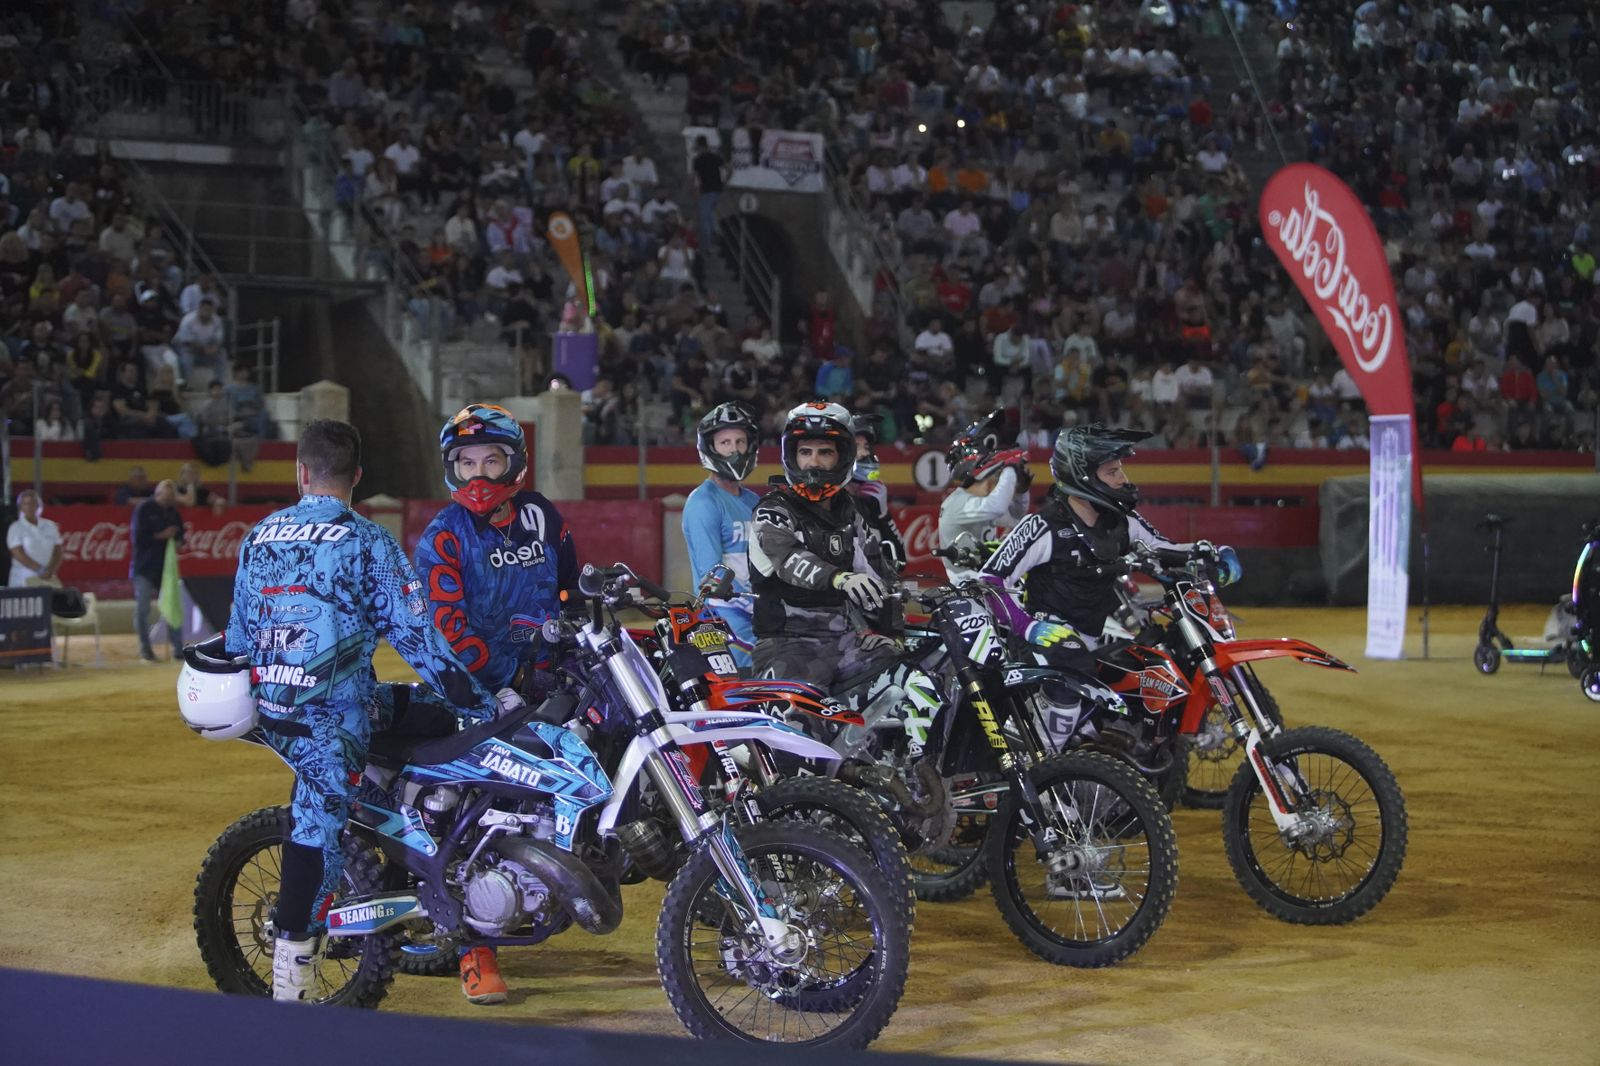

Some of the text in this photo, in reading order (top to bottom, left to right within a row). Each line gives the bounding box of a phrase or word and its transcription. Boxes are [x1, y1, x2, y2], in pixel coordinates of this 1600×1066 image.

[926, 456, 938, 487] 1
[253, 523, 351, 545] JABATO
[522, 556, 546, 568] Racing
[783, 552, 823, 585] FOX
[707, 654, 738, 675] 98
[1138, 672, 1174, 697] TEAM PARRA
[479, 751, 541, 787] JABATO
[329, 904, 395, 929] BREAKING.ES
